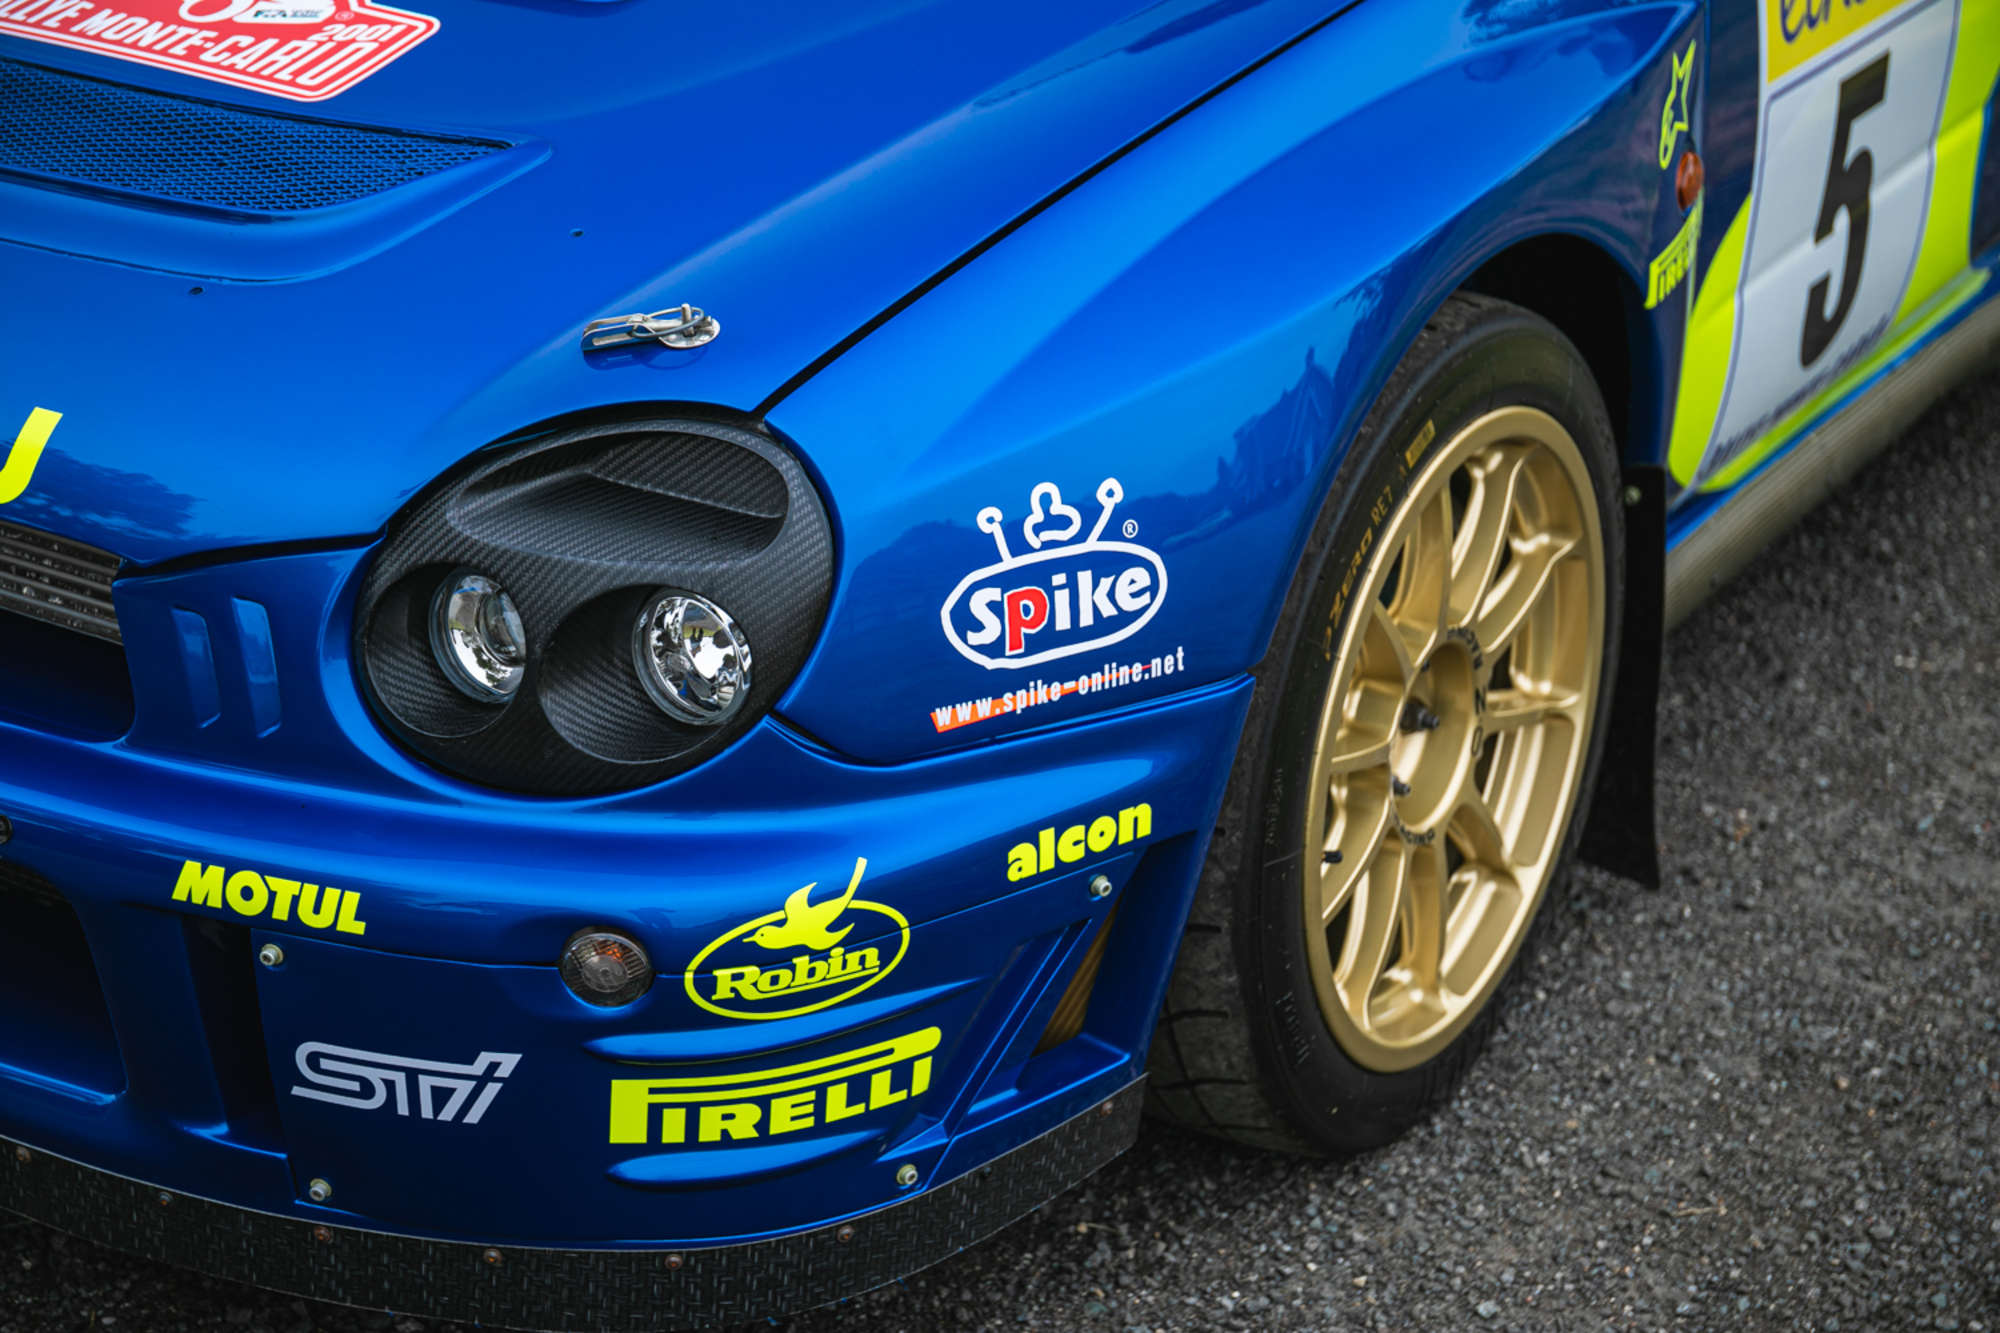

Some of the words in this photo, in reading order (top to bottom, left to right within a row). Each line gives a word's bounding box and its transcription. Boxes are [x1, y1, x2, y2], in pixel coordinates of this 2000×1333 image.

[0, 0, 95, 28] LLYE
[306, 23, 399, 43] 2001
[1800, 50, 1890, 368] 5
[966, 566, 1152, 656] Spike
[935, 646, 1184, 727] www.spike-online.net
[1007, 803, 1152, 882] alcon
[171, 860, 367, 936] MOTUL
[711, 945, 881, 1001] Robin
[609, 1026, 943, 1144] PIRELLI
